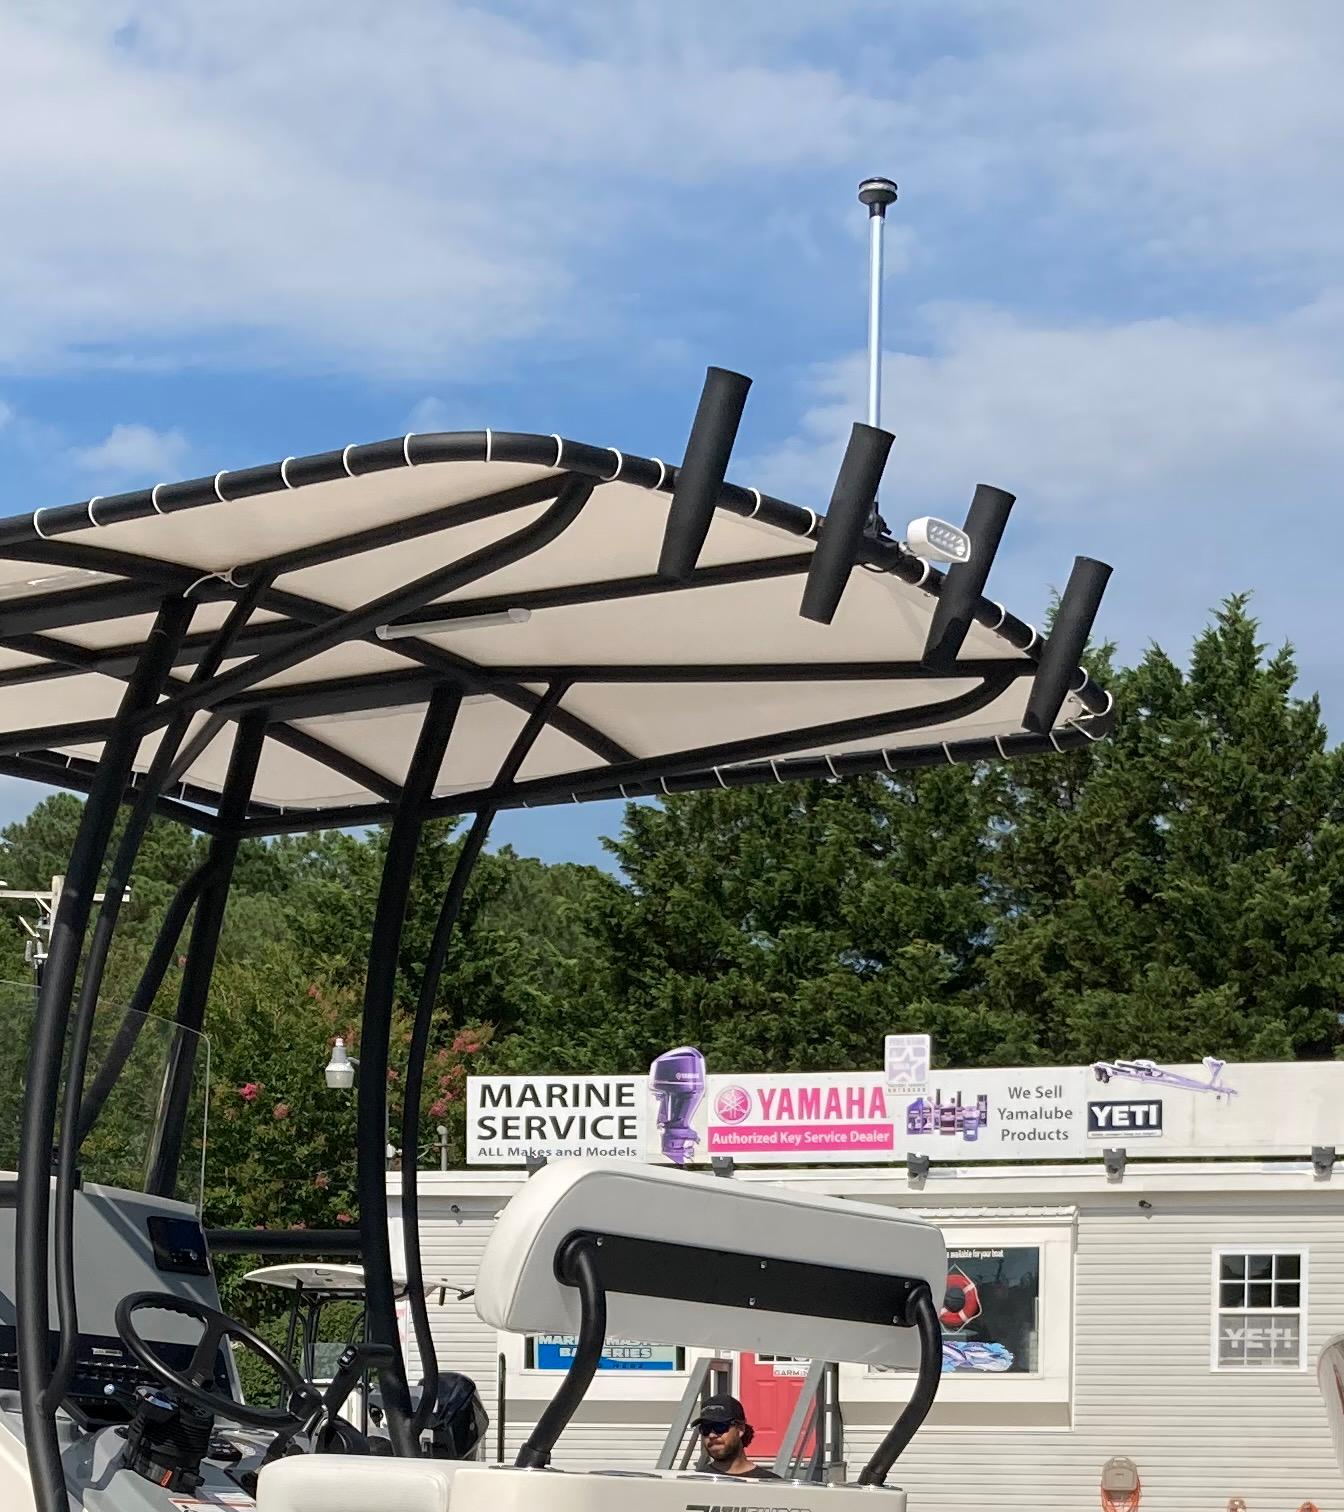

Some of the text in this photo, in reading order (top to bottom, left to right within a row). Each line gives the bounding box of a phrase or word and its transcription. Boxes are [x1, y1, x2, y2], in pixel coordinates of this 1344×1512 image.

[479, 1083, 635, 1108] MARINE
[1008, 1085, 1063, 1099] We Sell
[756, 1086, 888, 1121] YAMAHA
[997, 1106, 1073, 1120] Yamalube
[1091, 1104, 1159, 1127] YETI
[477, 1115, 638, 1140] SERVICE
[1001, 1128, 1069, 1141] Products
[712, 1129, 890, 1146] Authorized Key Service Dealer
[478, 1147, 637, 1157] ALL Makes and Models
[1224, 1328, 1291, 1348] YETI
[559, 1347, 652, 1359] BAERIES
